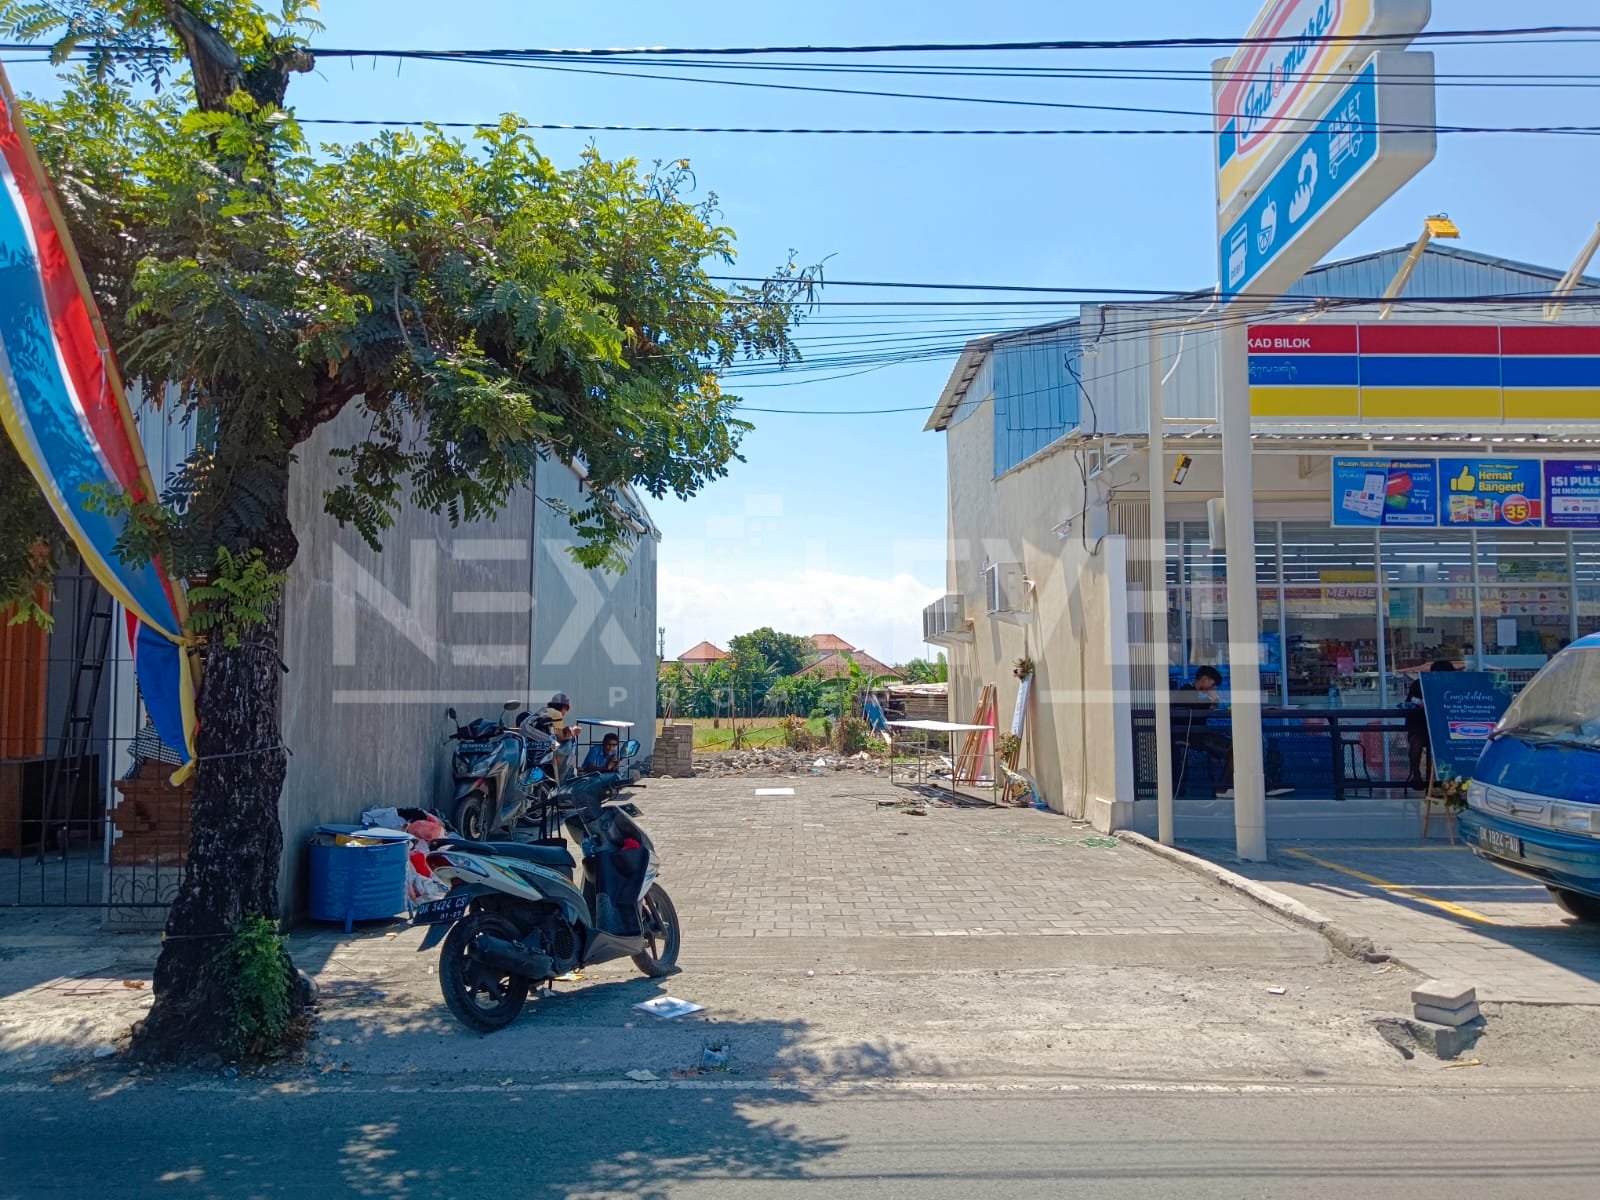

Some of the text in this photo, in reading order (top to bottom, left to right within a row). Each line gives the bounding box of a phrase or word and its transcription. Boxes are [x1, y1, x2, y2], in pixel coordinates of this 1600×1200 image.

[1328, 91, 1361, 141] PAKET
[1274, 338, 1311, 348] BILOK
[1479, 471, 1512, 480] Hemat
[1552, 476, 1568, 487] ISI
[1506, 505, 1528, 519] 35
